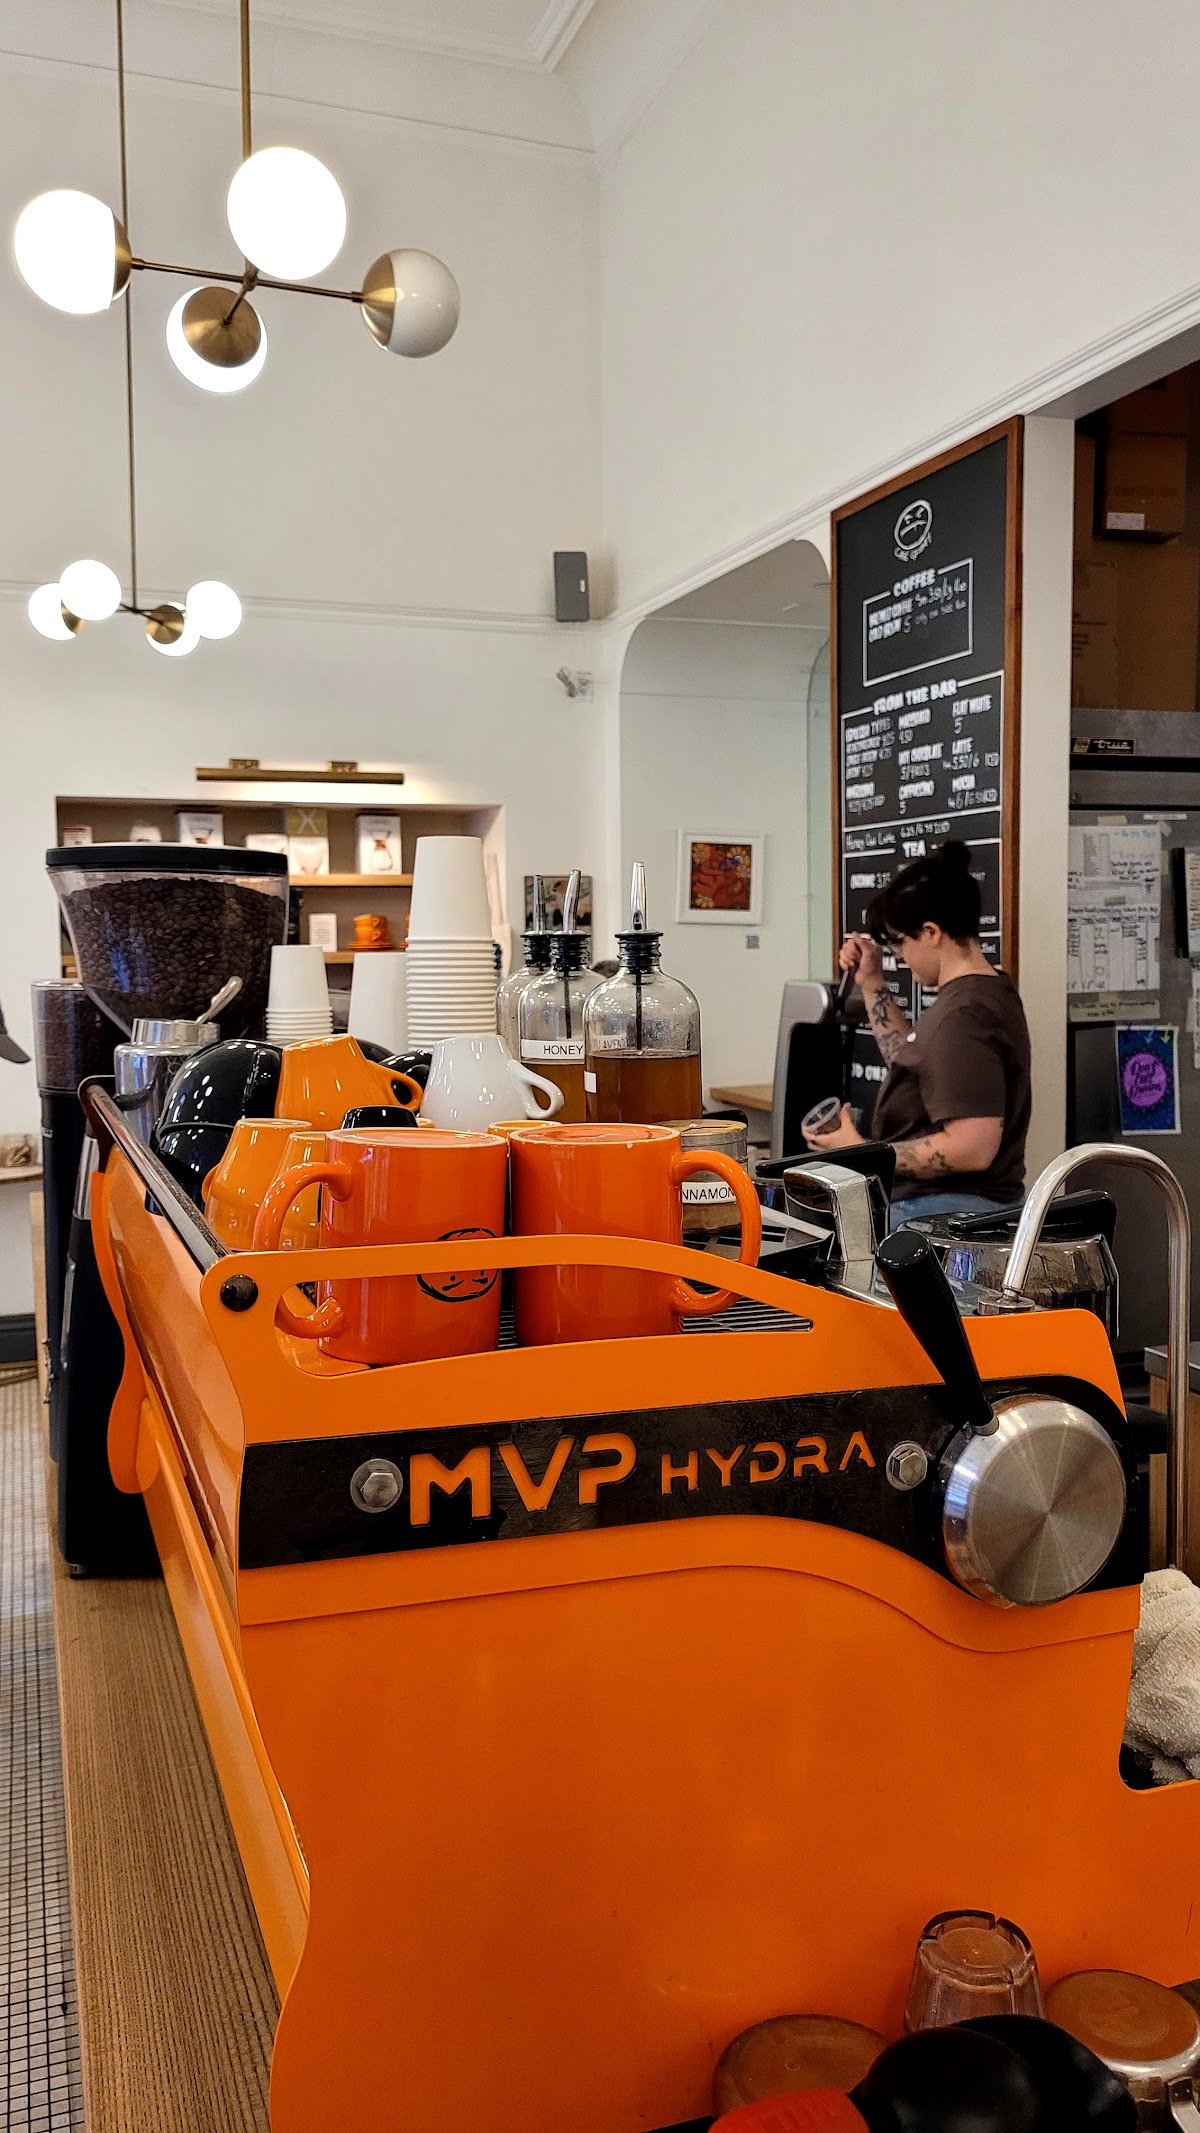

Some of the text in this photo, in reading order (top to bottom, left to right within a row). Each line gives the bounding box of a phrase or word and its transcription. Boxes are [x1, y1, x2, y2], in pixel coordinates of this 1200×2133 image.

[893, 567, 936, 598] COFFEE
[873, 678, 958, 716] FROM THE BAR
[954, 717, 963, 734] 5
[900, 800, 907, 814] 5
[902, 840, 926, 858] TEA
[543, 1045, 584, 1055] HONEY
[410, 1430, 877, 1527] MVP HYDRA
